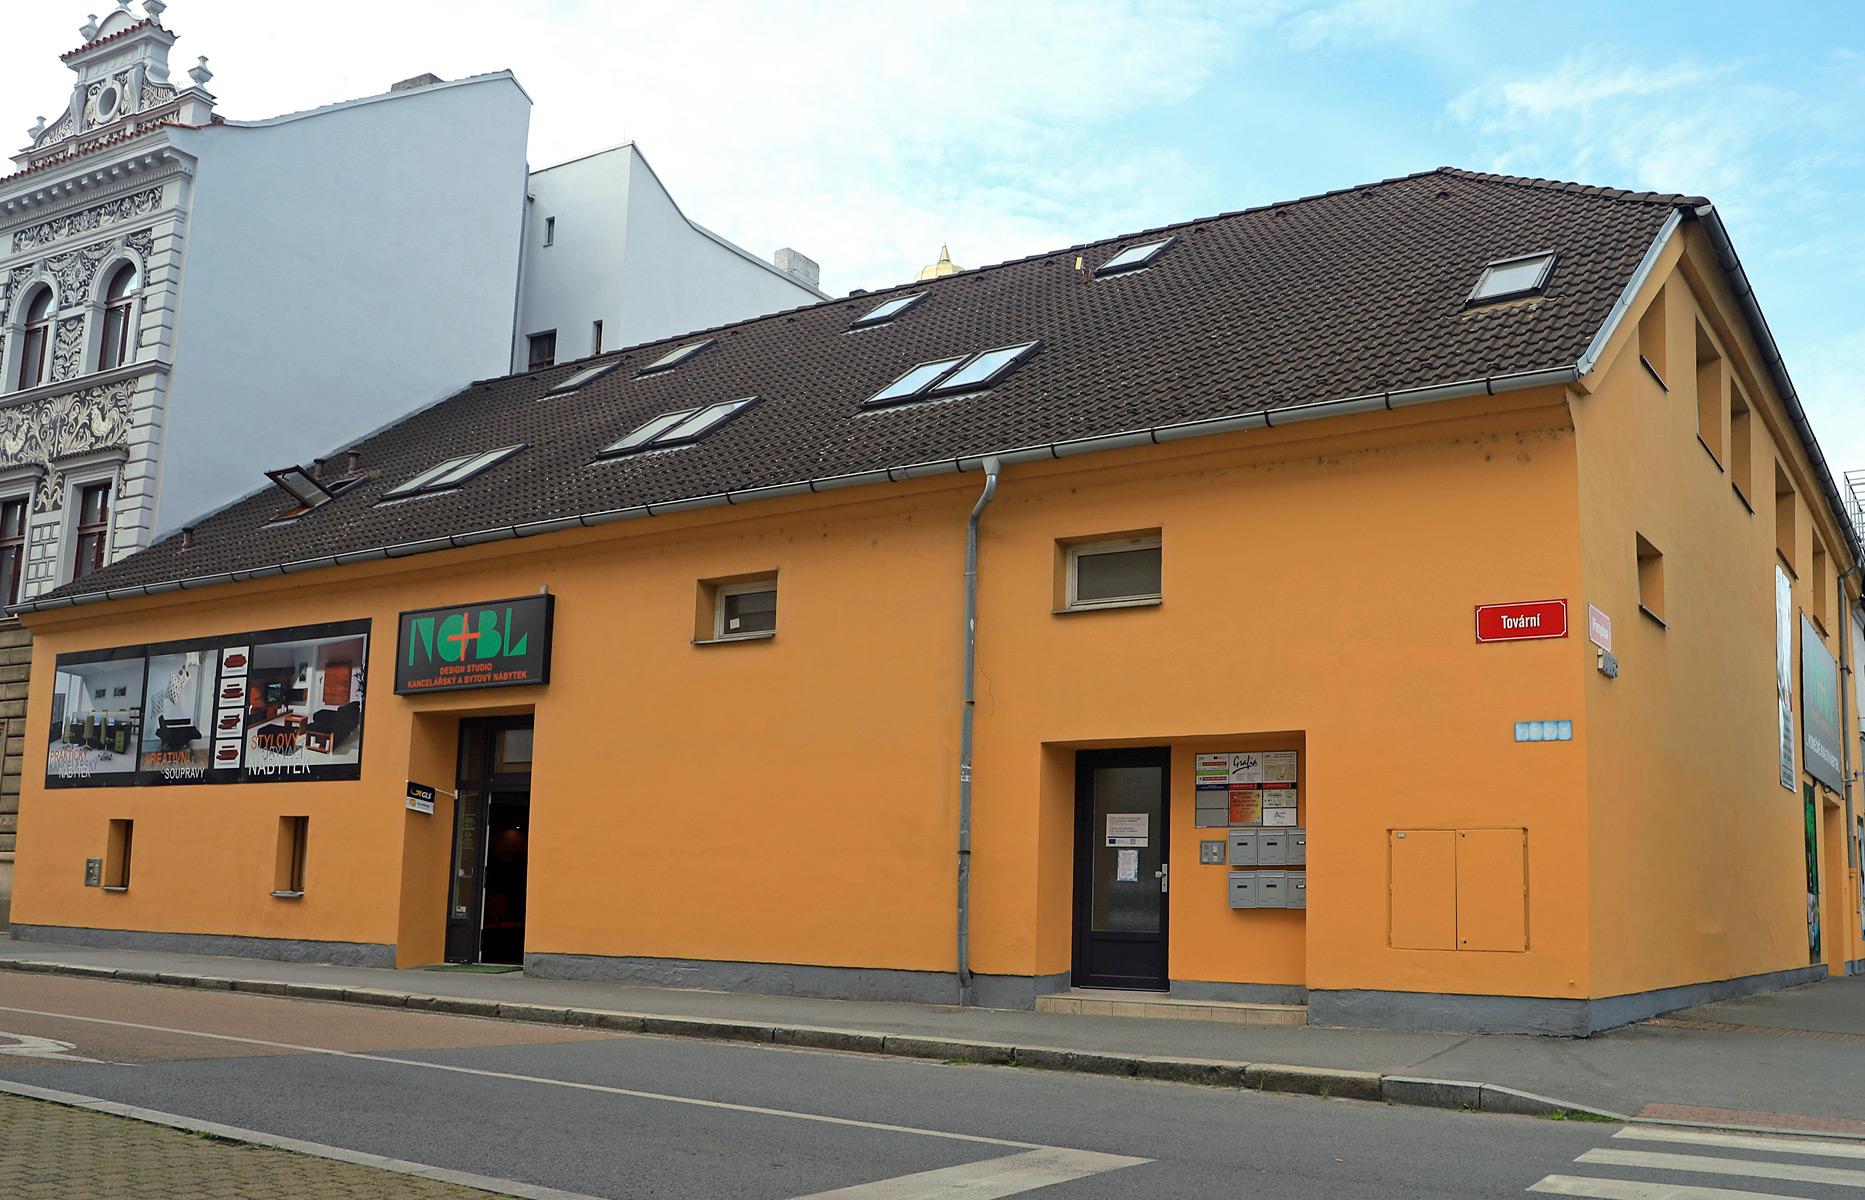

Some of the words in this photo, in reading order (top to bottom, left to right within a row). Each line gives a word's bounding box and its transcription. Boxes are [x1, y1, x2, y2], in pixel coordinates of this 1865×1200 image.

[1501, 613, 1541, 629] Tovární
[440, 665, 465, 675] DESIGN
[467, 663, 493, 673] STUDIO
[458, 676, 463, 684] A
[464, 673, 492, 684] BYTOVÝ
[493, 670, 528, 681] NÁBYTEK
[251, 730, 299, 750] STYLOVÝ
[164, 767, 205, 779] SOUPRAVY
[421, 791, 432, 800] GLS
